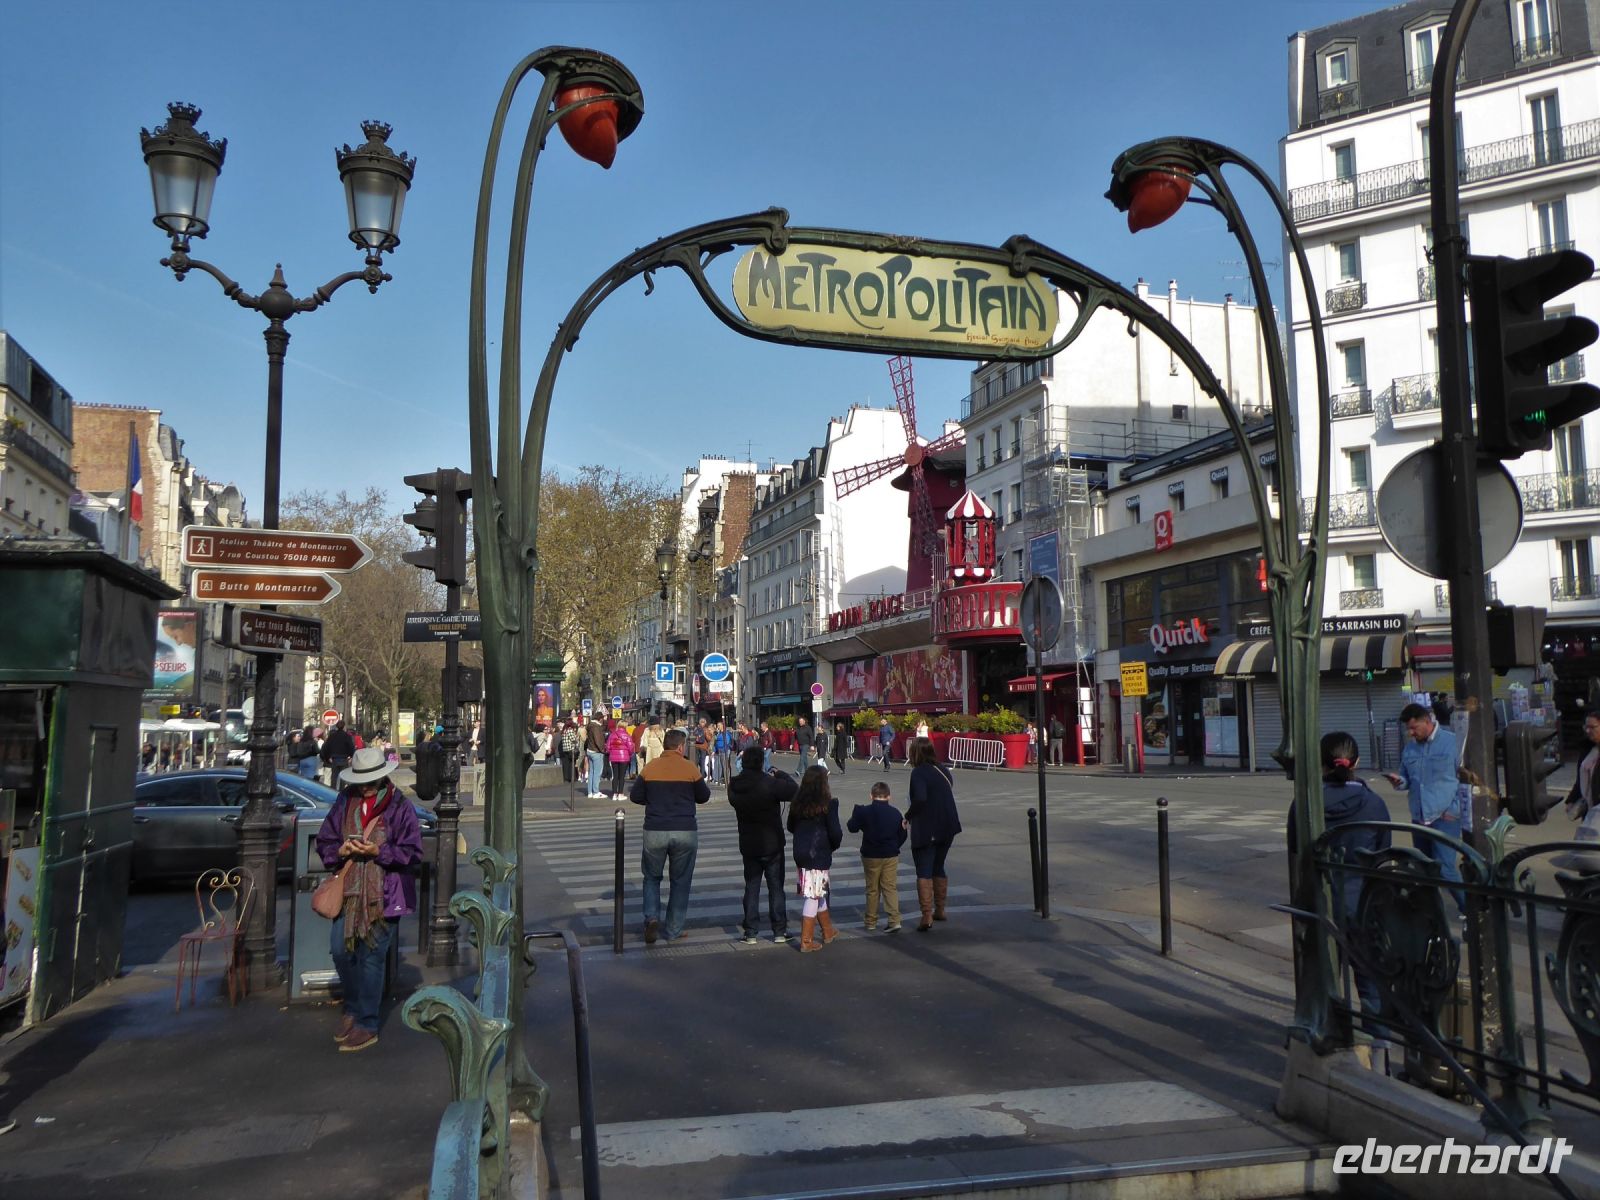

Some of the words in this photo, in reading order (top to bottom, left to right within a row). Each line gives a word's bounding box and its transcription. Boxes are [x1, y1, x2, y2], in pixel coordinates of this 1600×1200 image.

[748, 251, 1046, 335] METROPOLITAIN
[1211, 468, 1228, 481] Quick
[1168, 483, 1184, 494] Quick
[1156, 515, 1168, 537] Q
[219, 537, 249, 546] Atelier
[253, 539, 283, 548] Théâtre
[287, 541, 296, 549] de
[300, 542, 347, 551] Montmartre
[245, 551, 279, 560] Coustou
[283, 553, 308, 561] 75018
[311, 554, 336, 563] PARIS
[219, 581, 249, 591] Butte
[255, 581, 318, 592] Montmartre
[829, 605, 862, 632] MOULIN
[868, 593, 904, 623] ROUGE
[255, 618, 266, 629] Les
[268, 621, 283, 632] trois
[406, 615, 440, 624] IMMERSIVE
[441, 615, 461, 623] GAME
[1336, 619, 1381, 632] SARRASIN
[1383, 618, 1401, 629] BIO
[1149, 616, 1207, 654] Quick
[660, 667, 669, 678] P
[1148, 665, 1169, 677] Quality
[1170, 664, 1189, 676] Burger
